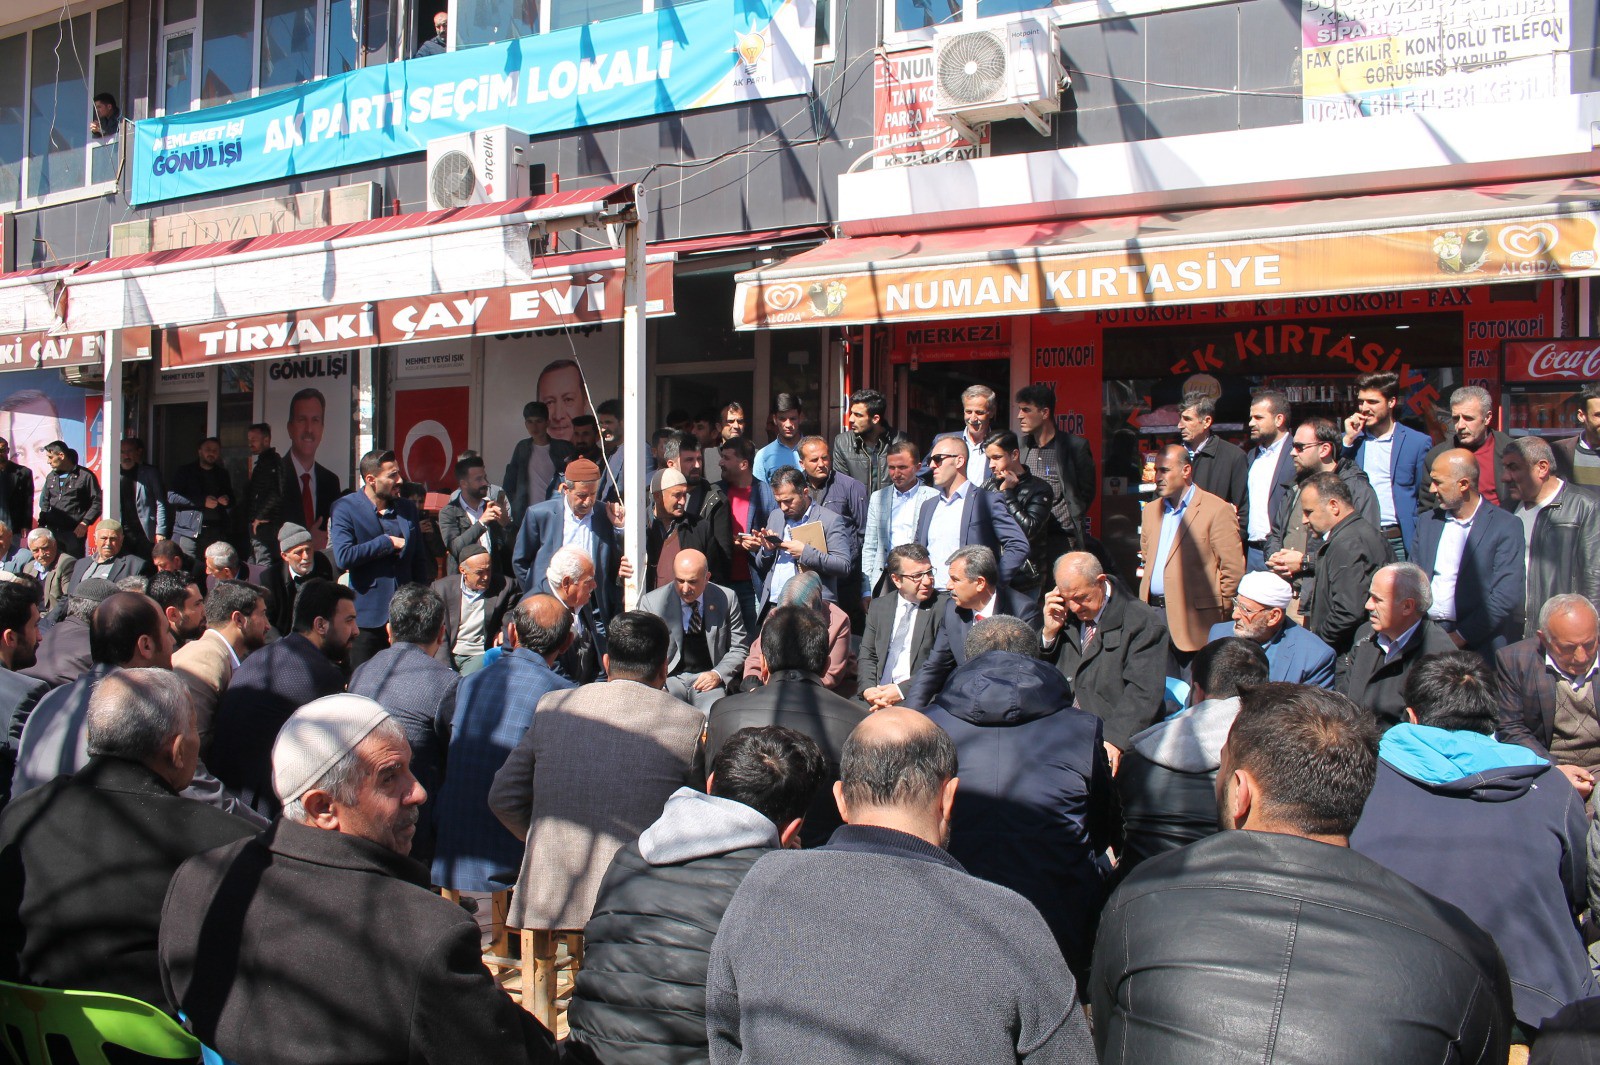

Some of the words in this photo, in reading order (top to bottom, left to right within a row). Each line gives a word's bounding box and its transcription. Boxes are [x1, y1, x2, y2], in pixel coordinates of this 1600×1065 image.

[1011, 29, 1040, 38] Hotpoint
[1307, 50, 1331, 69] FAX
[1405, 25, 1486, 56] KONTÖRLÜ
[1491, 18, 1563, 43] TELEFON
[262, 113, 306, 154] AK
[309, 88, 404, 142] PARTİ
[408, 71, 519, 124] SEÇİM
[526, 40, 675, 105] LOKALİ
[891, 88, 917, 107] TAM
[884, 108, 923, 129] PARÇA
[152, 125, 226, 151] MEMLEKET
[152, 144, 217, 177] GÖNÜL
[218, 137, 243, 168] İŞİ
[483, 134, 495, 180] arçelik
[885, 273, 1029, 312] NUMAN
[1045, 251, 1281, 300] KIRTASİYE
[1427, 286, 1473, 307] FAX
[199, 303, 375, 356] TİRYAKİ
[392, 296, 489, 340] ÇAY
[509, 273, 606, 321] EVİ
[1468, 313, 1544, 339] FOTOKOPİ
[905, 321, 1001, 345] MERKEZİ
[30, 338, 73, 368] ÇAY
[269, 357, 327, 381] GÖNÜL
[327, 353, 347, 380] İŞİ
[405, 356, 431, 366] MEHMET
[1035, 340, 1096, 369] FOTOKOPİ
